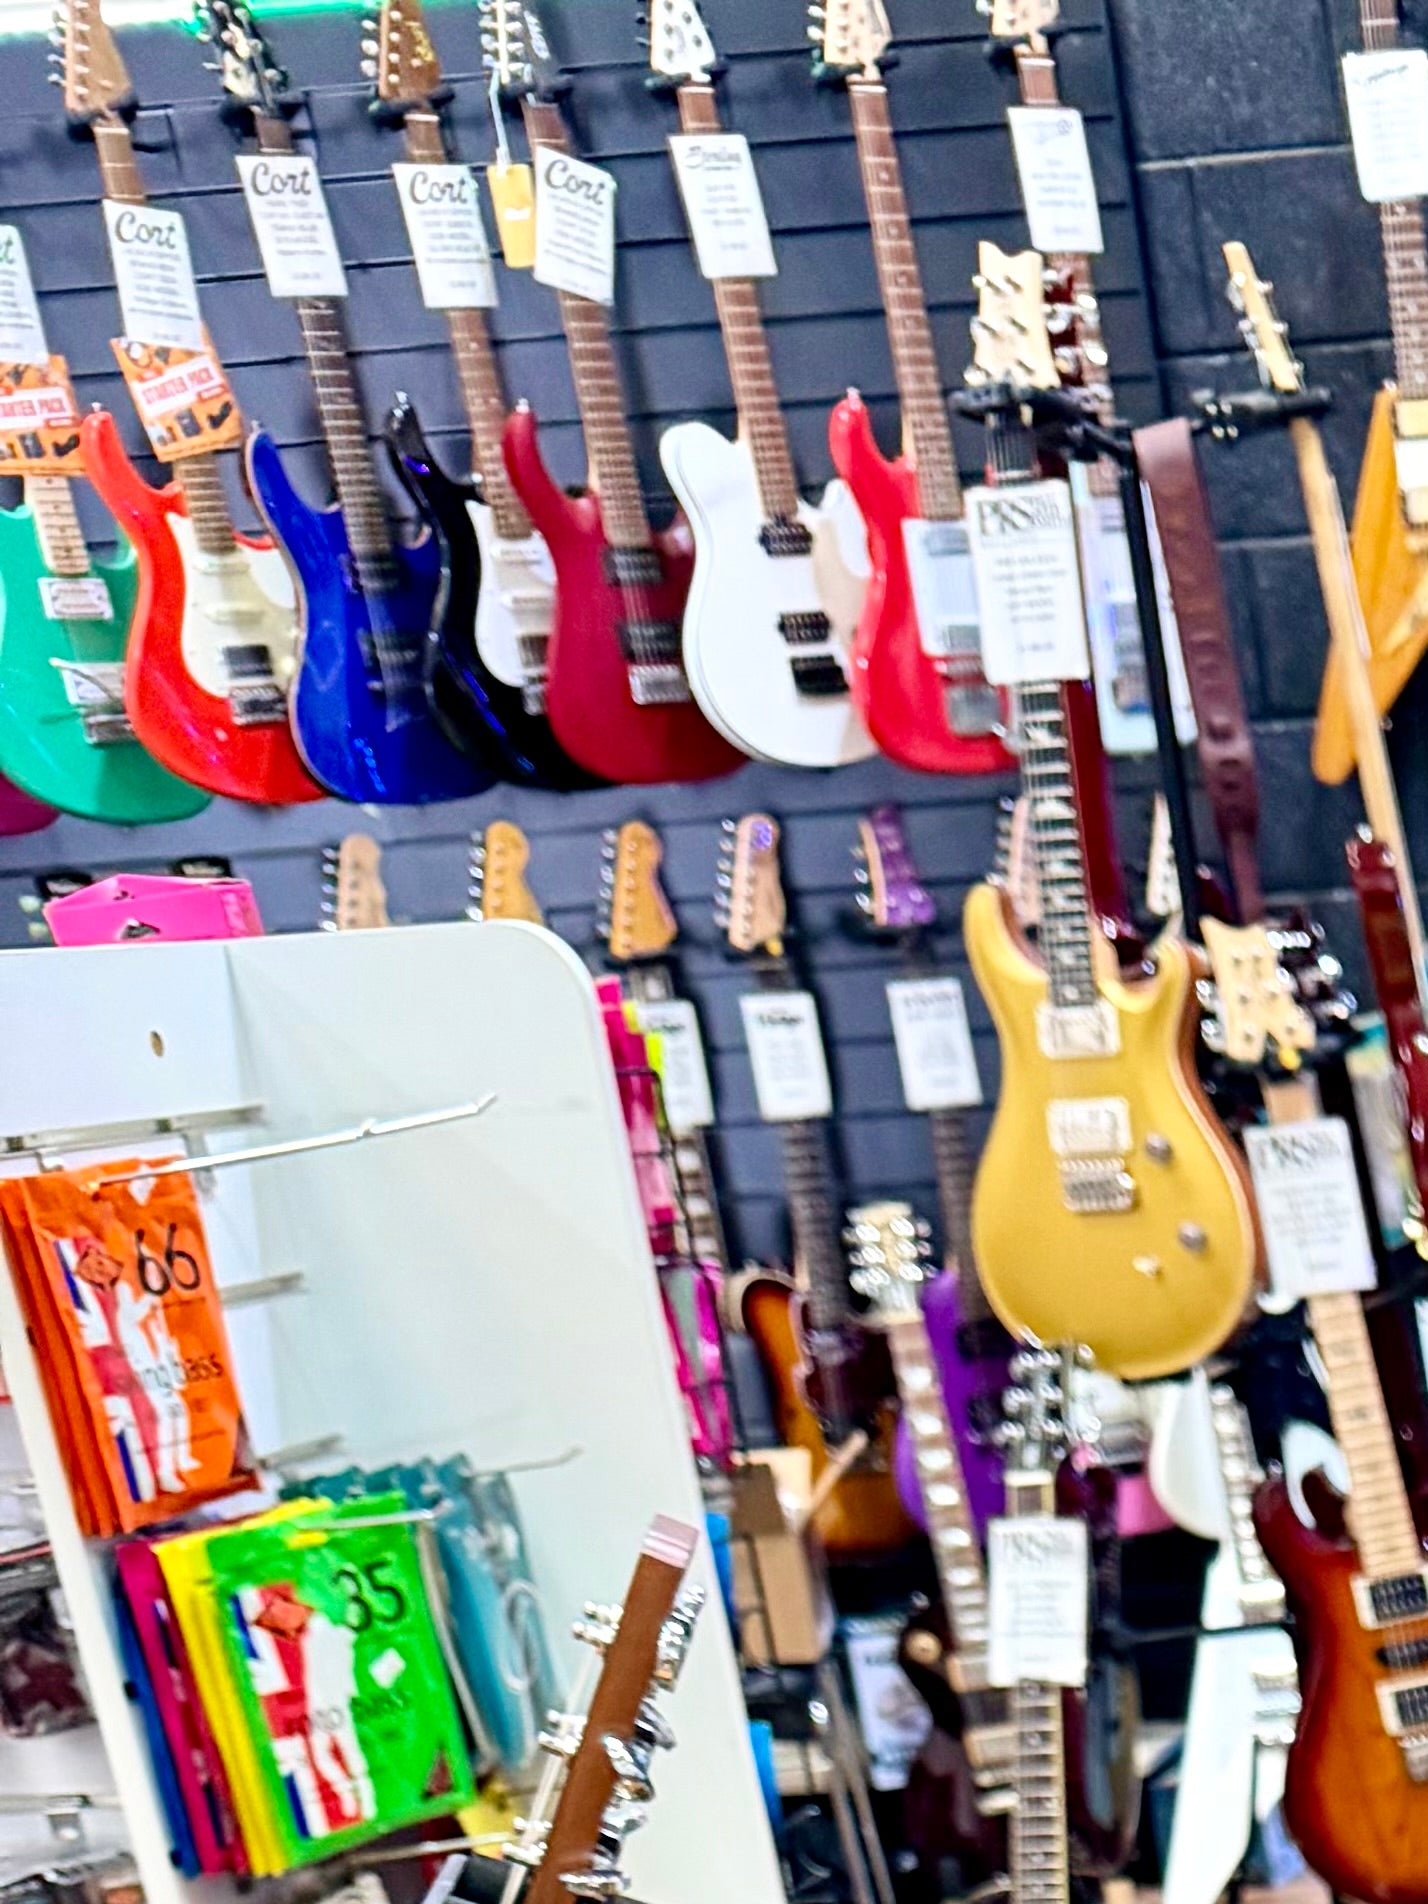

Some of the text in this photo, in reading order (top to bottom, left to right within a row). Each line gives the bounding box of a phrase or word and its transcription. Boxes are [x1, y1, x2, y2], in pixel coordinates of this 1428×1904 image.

[250, 162, 313, 196] Cort
[409, 169, 469, 205] Cort
[544, 157, 605, 206] Cort
[114, 210, 177, 249] Cort
[136, 1222, 201, 1297] 66
[330, 1559, 406, 1633] 35
